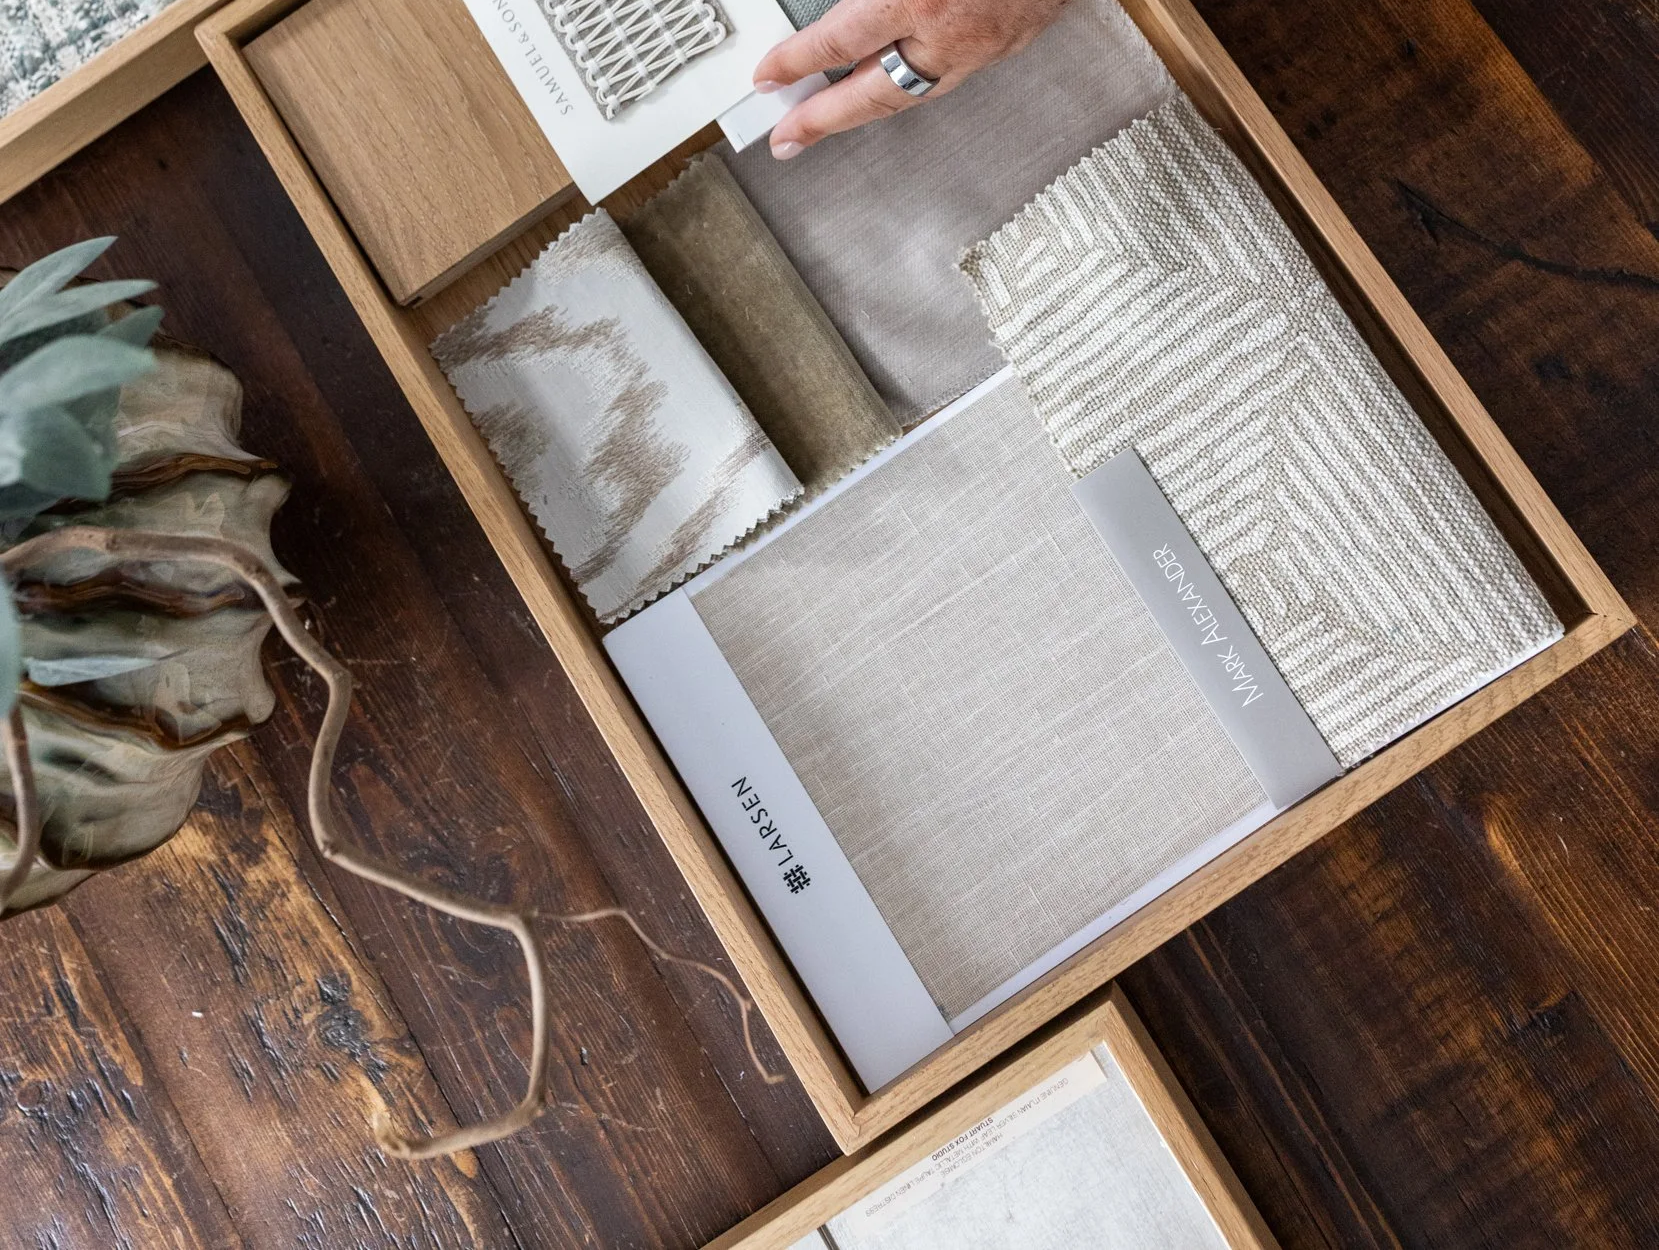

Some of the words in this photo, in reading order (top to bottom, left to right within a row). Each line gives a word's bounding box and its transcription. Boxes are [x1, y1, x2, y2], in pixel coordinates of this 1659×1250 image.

[525, 44, 573, 115] SAMUEL
[1153, 543, 1228, 645] ALEXANDER
[731, 776, 794, 866] LARSEN
[1040, 1077, 1068, 1099] GENUINE
[968, 1117, 993, 1135] STUART
[995, 1112, 1018, 1129] SILVER
[954, 1134, 968, 1145] FOX
[981, 1126, 996, 1139] LEAF
[931, 1143, 954, 1160] STUDIO
[963, 1137, 979, 1151] WITH
[971, 1132, 1003, 1156] HAMILTON
[934, 1148, 963, 1170] METALLIC
[914, 1167, 935, 1183] TAUPE
[895, 1180, 915, 1196] LINEN
[864, 1193, 896, 1216] DISTRESS
